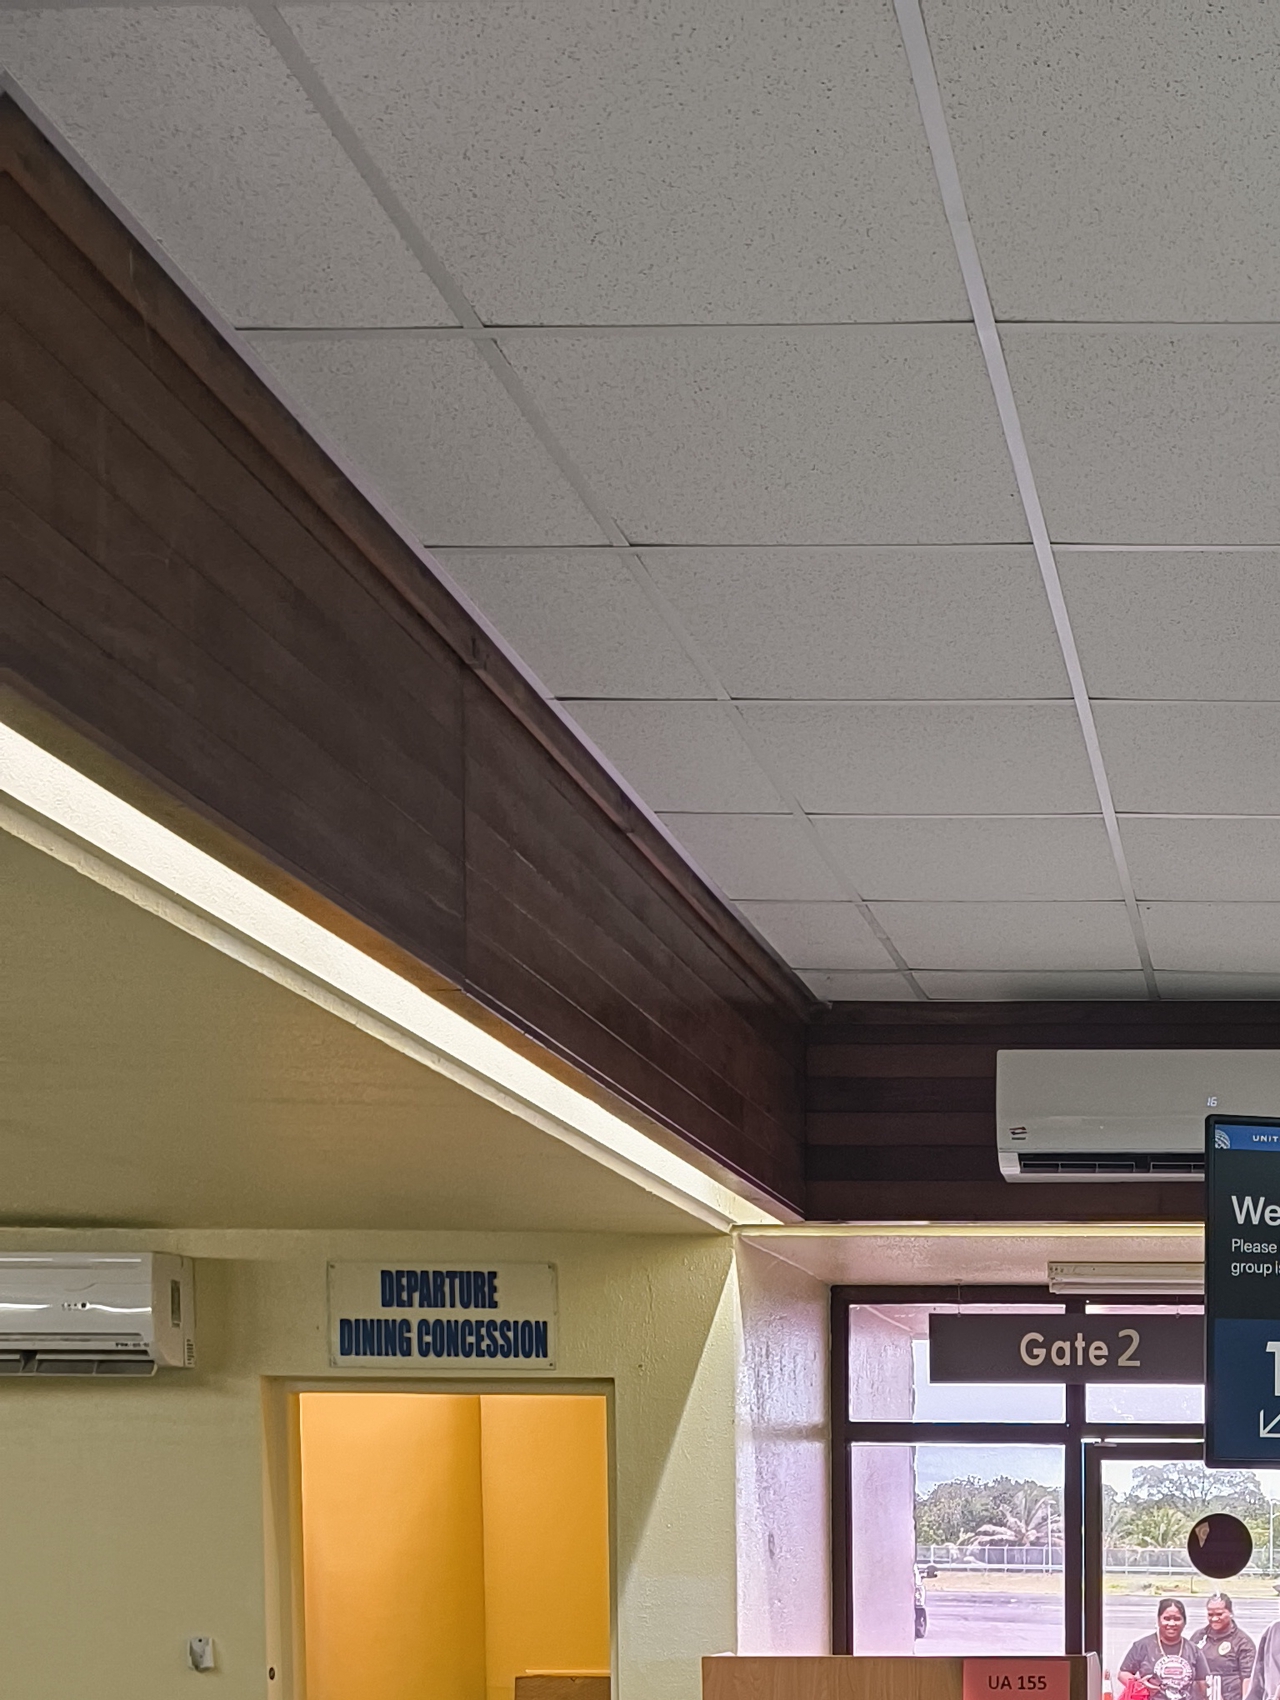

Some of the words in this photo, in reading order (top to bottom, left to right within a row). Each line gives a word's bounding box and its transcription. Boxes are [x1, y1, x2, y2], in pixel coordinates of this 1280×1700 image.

[1231, 1238, 1278, 1254] Please
[1231, 1262, 1273, 1277] group
[380, 1269, 499, 1309] DEPARTURE
[339, 1318, 412, 1357] DINING
[416, 1319, 549, 1359] CONCESSION
[1020, 1331, 1109, 1367] Gate
[1117, 1328, 1141, 1367] 2
[988, 1675, 1012, 1690] UA
[1017, 1675, 1047, 1690] 155
